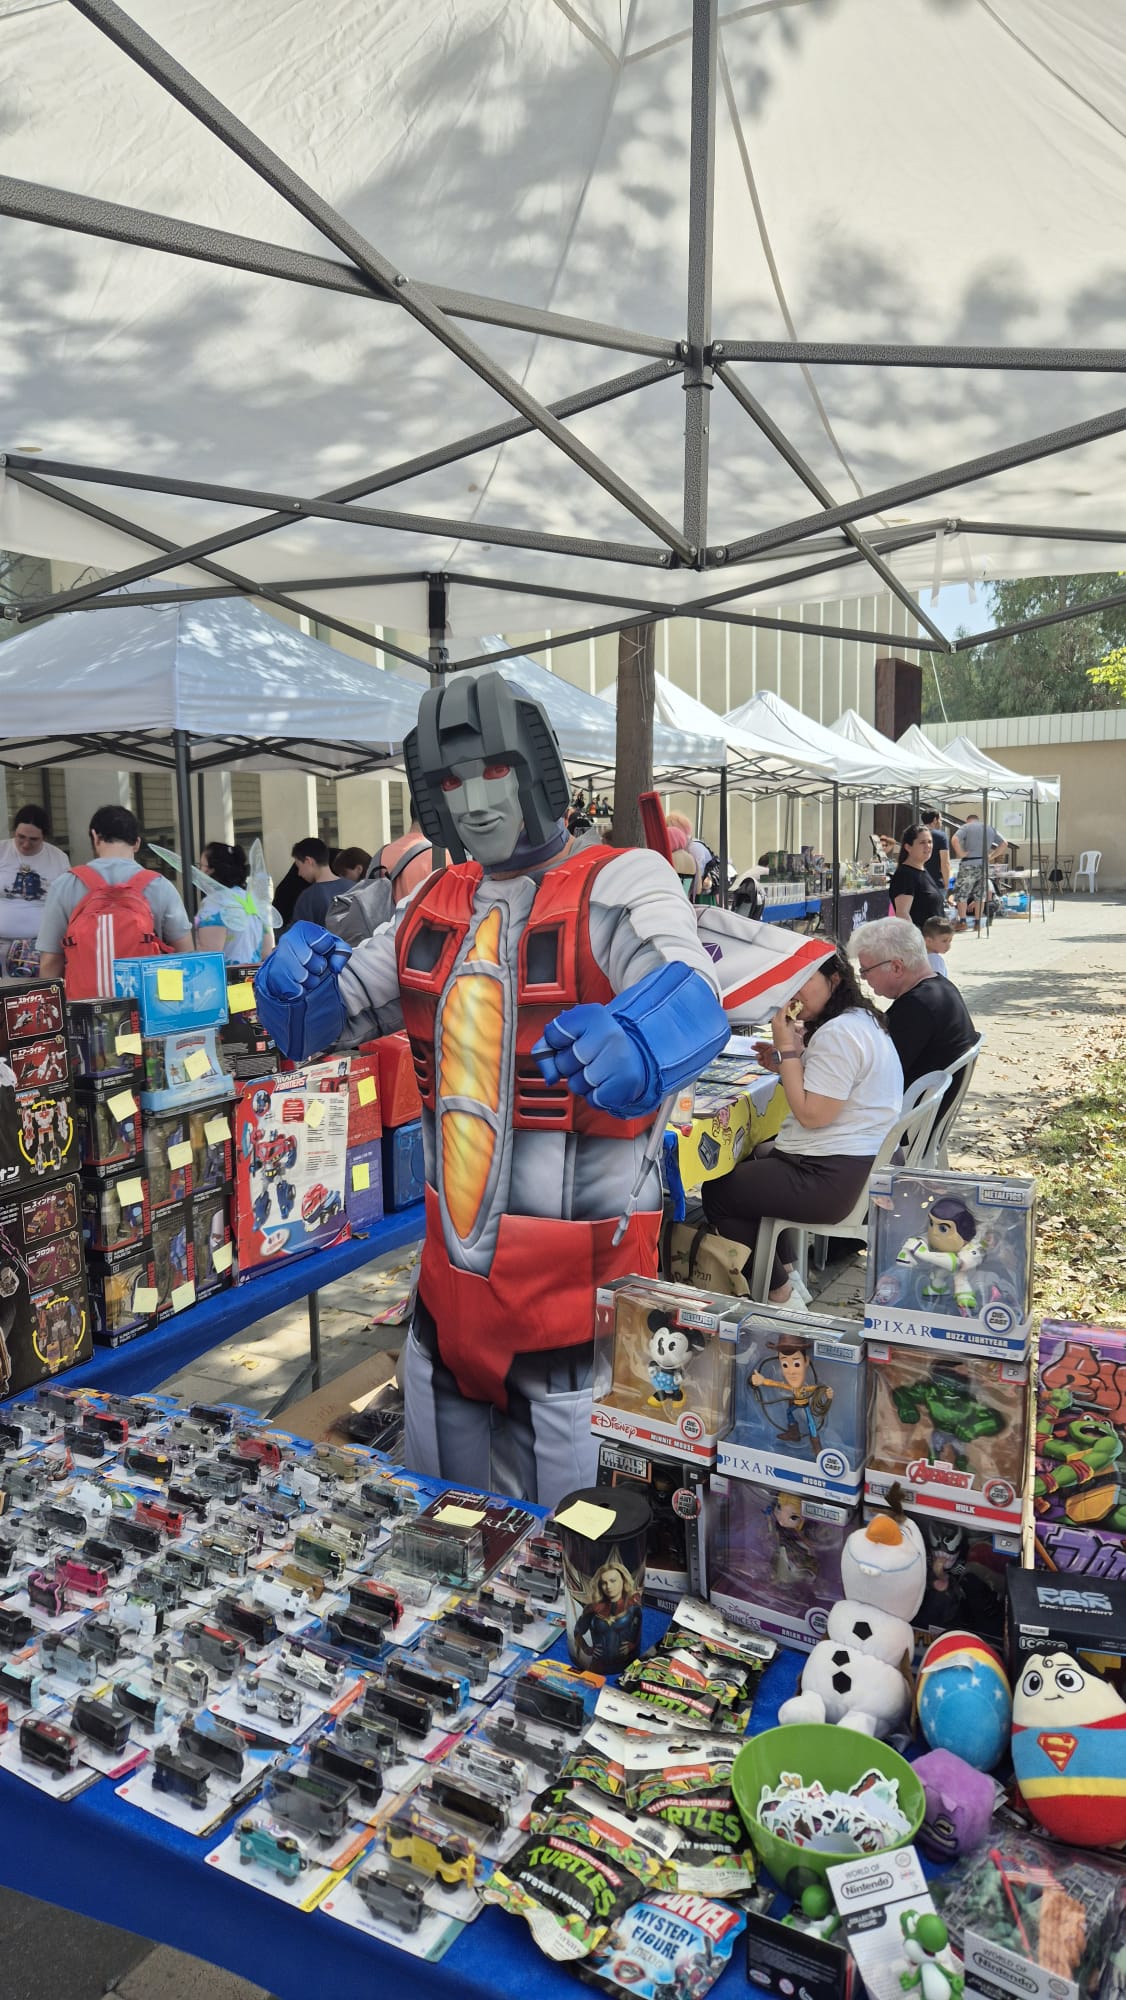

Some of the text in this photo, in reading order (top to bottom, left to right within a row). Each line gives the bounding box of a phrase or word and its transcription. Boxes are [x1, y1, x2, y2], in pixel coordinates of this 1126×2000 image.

[873, 1318, 931, 1338] PIXAR
[946, 1331, 1009, 1348] BUZZ LIGHTYEAR
[593, 1410, 636, 1439] Disney
[673, 1440, 695, 1452] MOUSE
[603, 1451, 644, 1471] METALS
[723, 1455, 775, 1477] PIXAR
[802, 1475, 827, 1488] WOODY
[955, 1503, 975, 1514] HULK
[721, 1608, 761, 1631] PRINCESS
[693, 1842, 732, 1854] FIGURE
[527, 1846, 617, 1917] TURTLES
[845, 1876, 890, 1896] Nintendo
[519, 1871, 592, 1920] MYSTERY FIGURE
[633, 1908, 699, 1948] MYSTERY
[631, 1926, 681, 1961] FIGURE
[982, 1948, 1028, 1974] WORLD OF
[977, 1956, 1033, 1991] Nintendo
